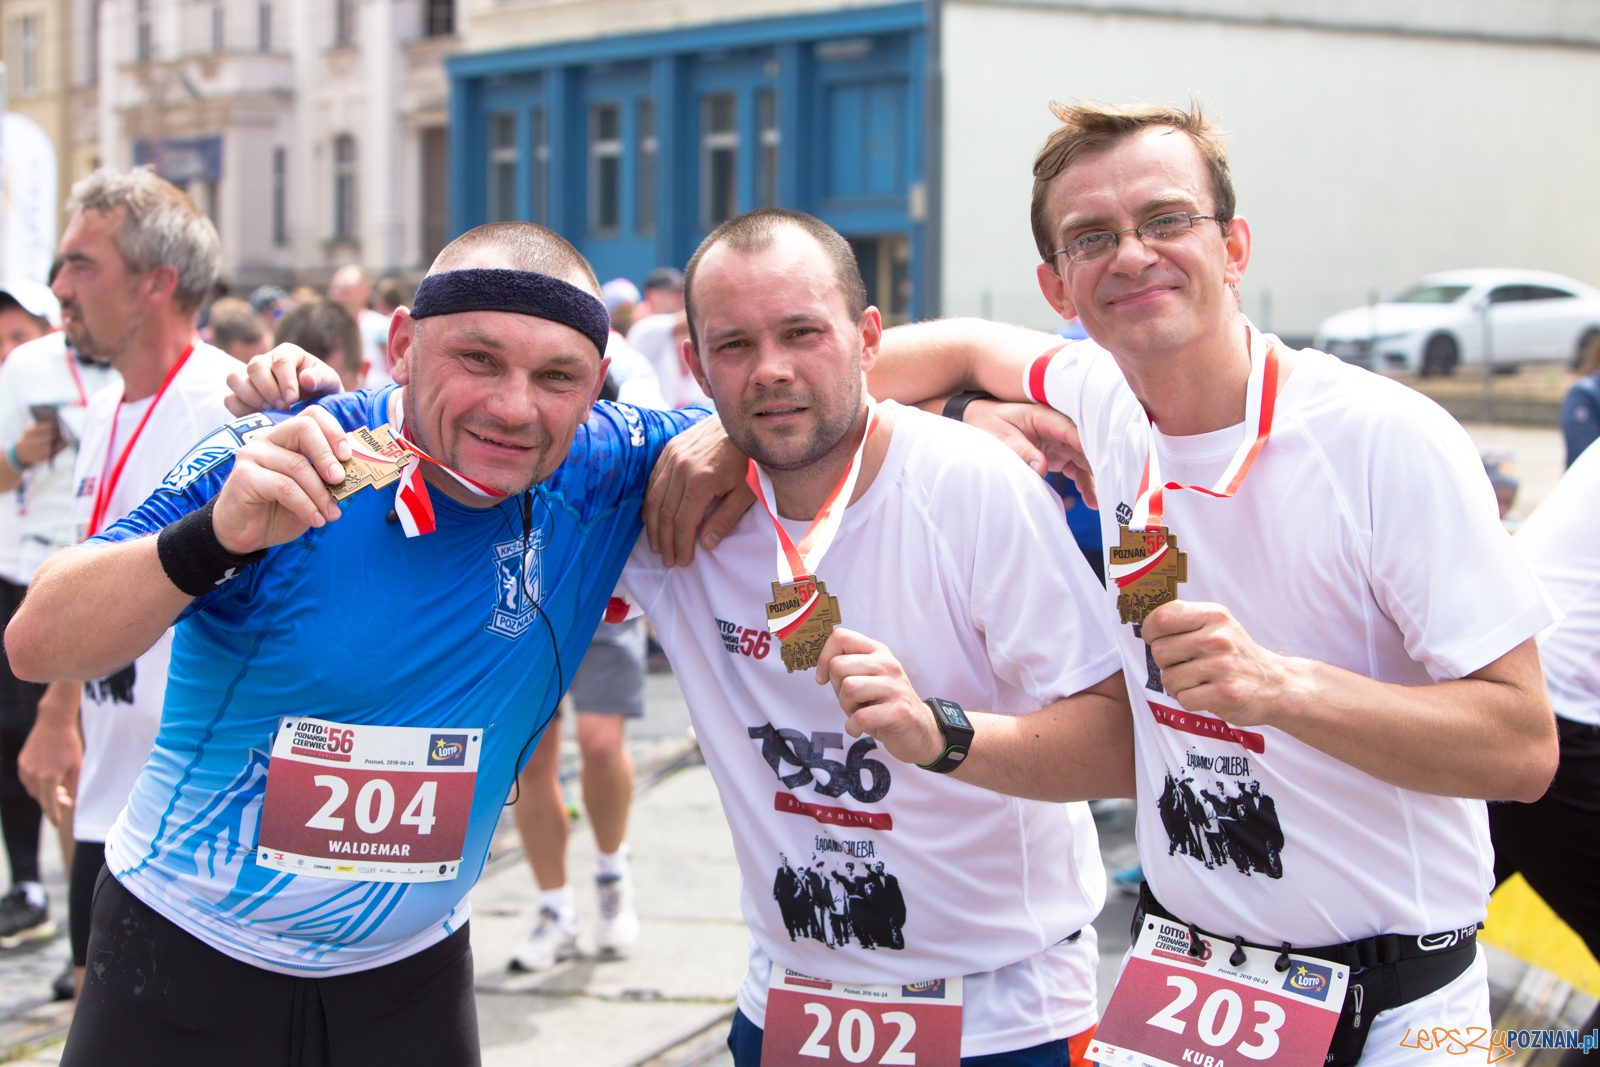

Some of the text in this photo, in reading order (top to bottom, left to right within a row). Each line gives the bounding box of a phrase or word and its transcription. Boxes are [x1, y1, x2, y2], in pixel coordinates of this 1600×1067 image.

[358, 428, 383, 452] POZNAŃ
[1113, 546, 1146, 559] POZNAŃ
[769, 597, 800, 614] POZNAŃ
[735, 625, 772, 660] '56
[1156, 709, 1186, 725] BIEG
[296, 722, 323, 735] LOTTO
[292, 738, 326, 750] CZERWIEC
[294, 731, 327, 743] POZNAŃSKI
[323, 726, 355, 754] '56
[438, 746, 458, 757] LOTTO
[747, 721, 892, 804] 1956
[1214, 755, 1250, 777] CHLEBA
[304, 775, 438, 835] 204
[328, 840, 411, 857] WALDEMAR
[1160, 924, 1185, 940] LOTTO
[1155, 941, 1187, 954] CZERWIEC
[1157, 934, 1190, 949] POZNAŃSKI
[1239, 973, 1269, 985] 2018-06-24
[1298, 975, 1320, 986] LOTTO
[1145, 975, 1286, 1060] 203
[798, 1002, 917, 1066] 202
[1181, 1047, 1225, 1067] KUBA
